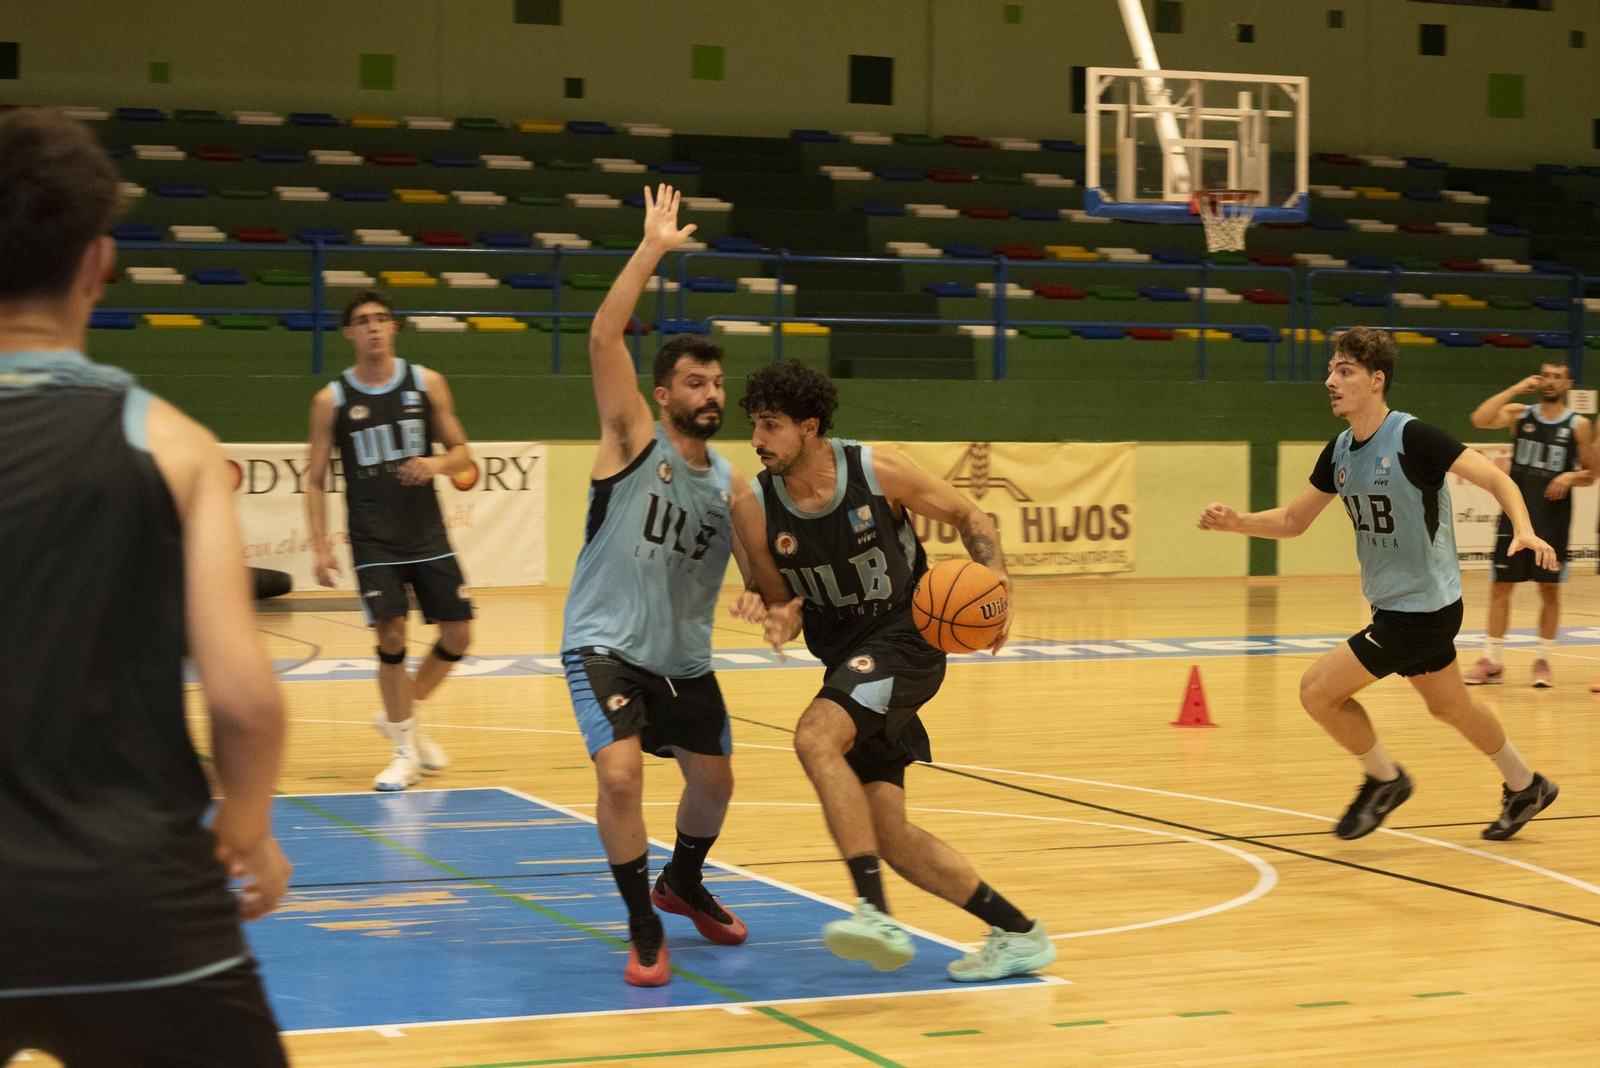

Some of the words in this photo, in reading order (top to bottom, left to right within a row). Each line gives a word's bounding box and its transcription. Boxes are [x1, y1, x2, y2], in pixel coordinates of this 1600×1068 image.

[349, 419, 426, 466] ULB
[1515, 438, 1568, 472] ULB
[643, 491, 717, 560] ULB
[854, 520, 871, 532] EBA
[1021, 503, 1130, 543] HIJOS
[779, 546, 893, 608] ULB
